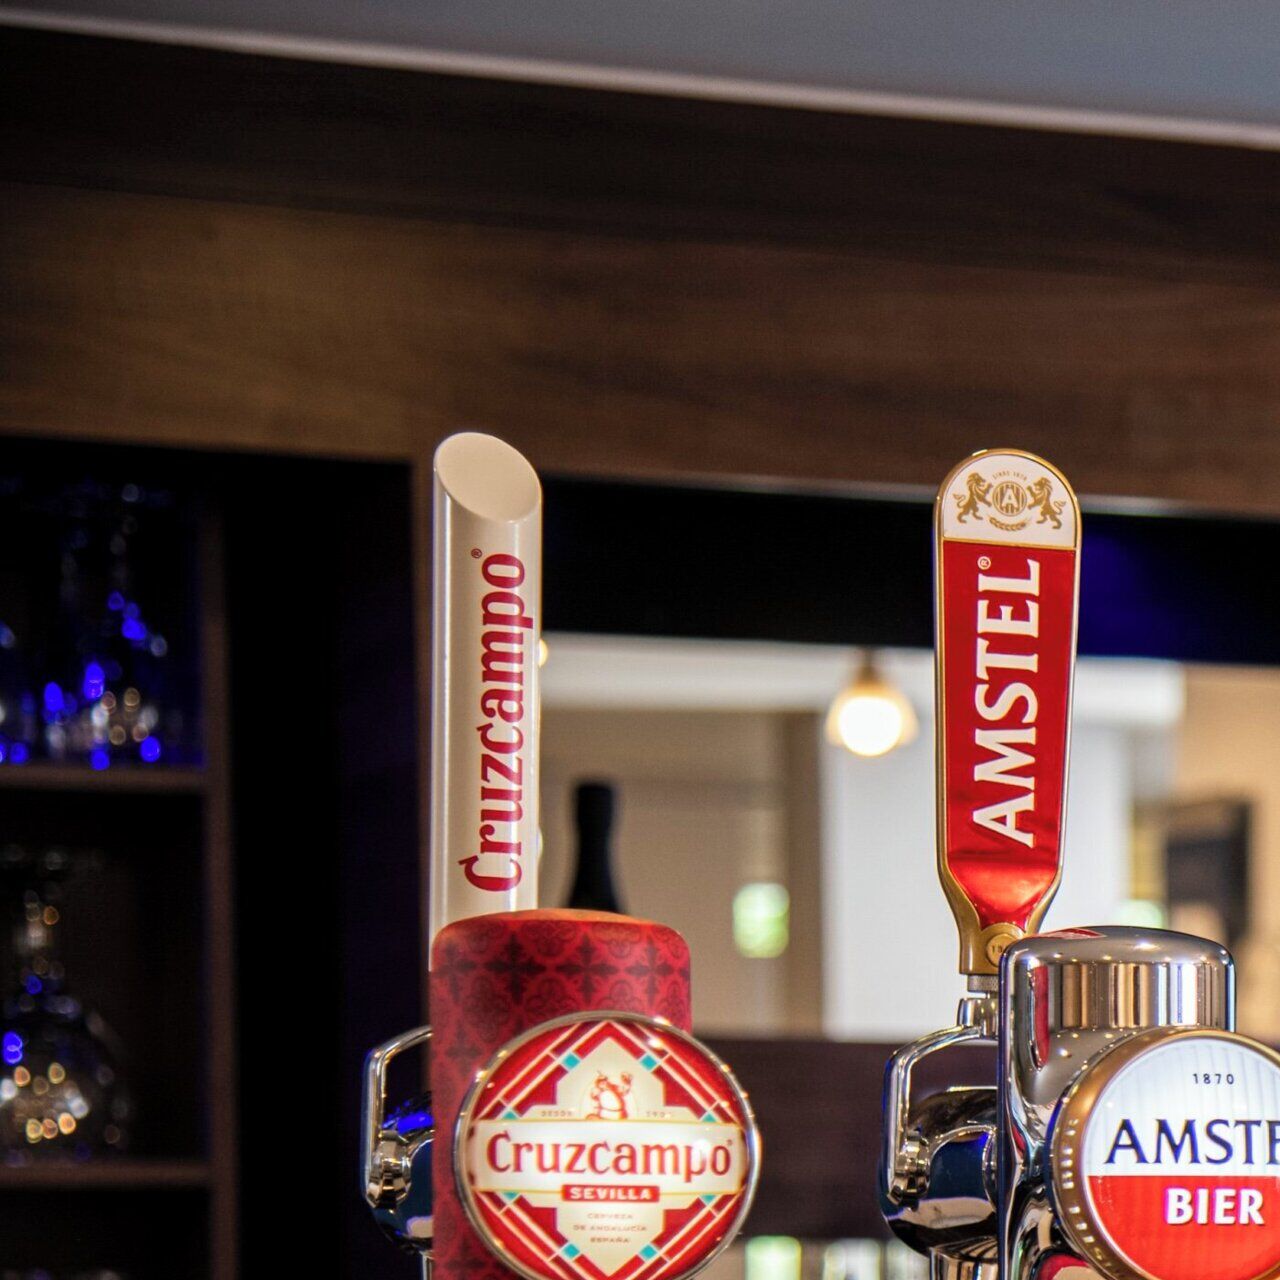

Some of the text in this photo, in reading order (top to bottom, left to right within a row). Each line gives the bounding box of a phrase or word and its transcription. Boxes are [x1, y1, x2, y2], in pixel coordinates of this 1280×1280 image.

[458, 552, 533, 892] Cruzcampo
[972, 558, 1041, 849] AMSTEL
[1192, 1073, 1235, 1085] 1870
[486, 1130, 732, 1183] Cruzcampo
[570, 1187, 652, 1200] SEVILLA
[1165, 1187, 1266, 1225] BIER
